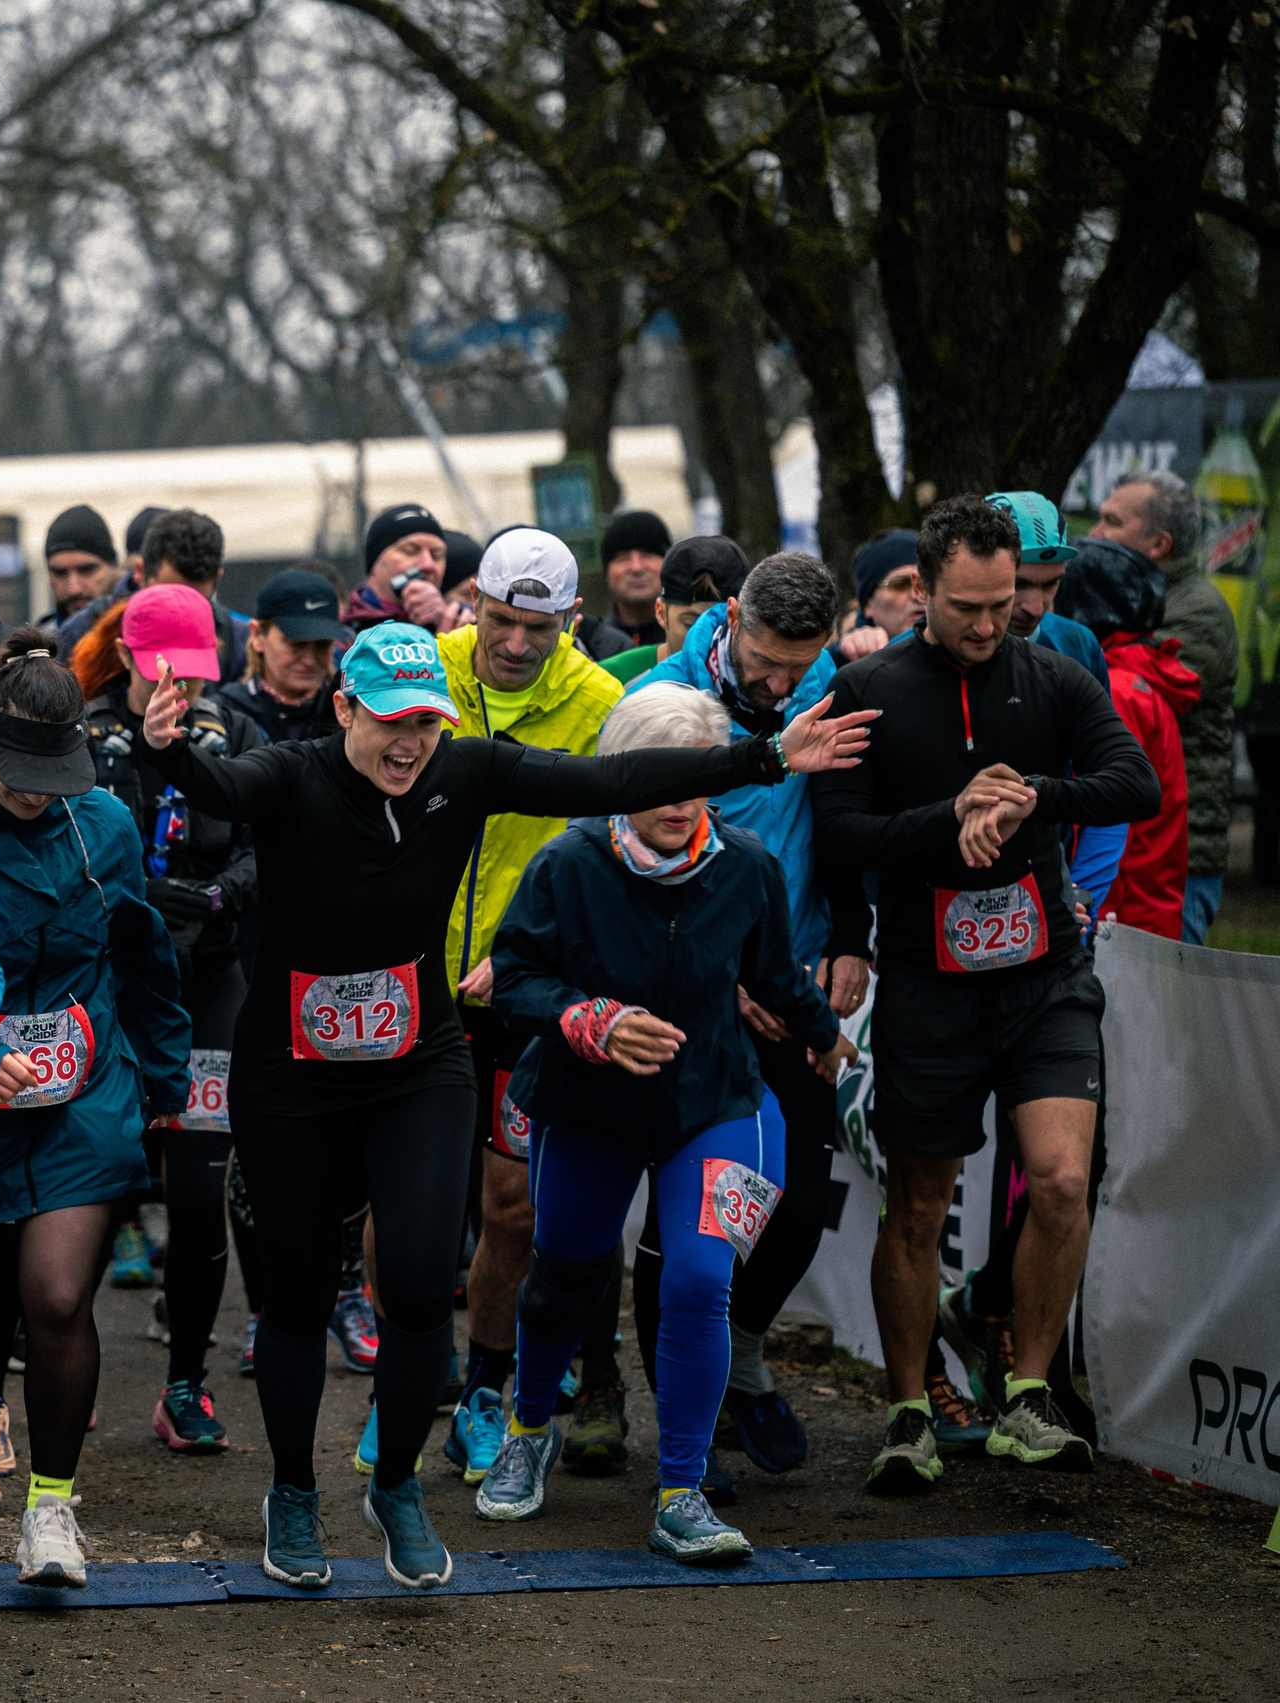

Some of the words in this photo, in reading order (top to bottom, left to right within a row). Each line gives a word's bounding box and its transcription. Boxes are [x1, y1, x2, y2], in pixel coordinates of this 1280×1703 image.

[393, 667, 435, 682] Audi
[986, 894, 1009, 904] RUN
[986, 902, 1010, 912] RIDE
[955, 908, 1031, 954] 325
[348, 981, 374, 991] RUN
[348, 989, 375, 999] RIDE
[314, 1000, 400, 1041] 312
[32, 1021, 57, 1032] RUN
[32, 1030, 58, 1040] RIDE
[13, 1042, 77, 1085] 68
[43, 1085, 66, 1095] maus
